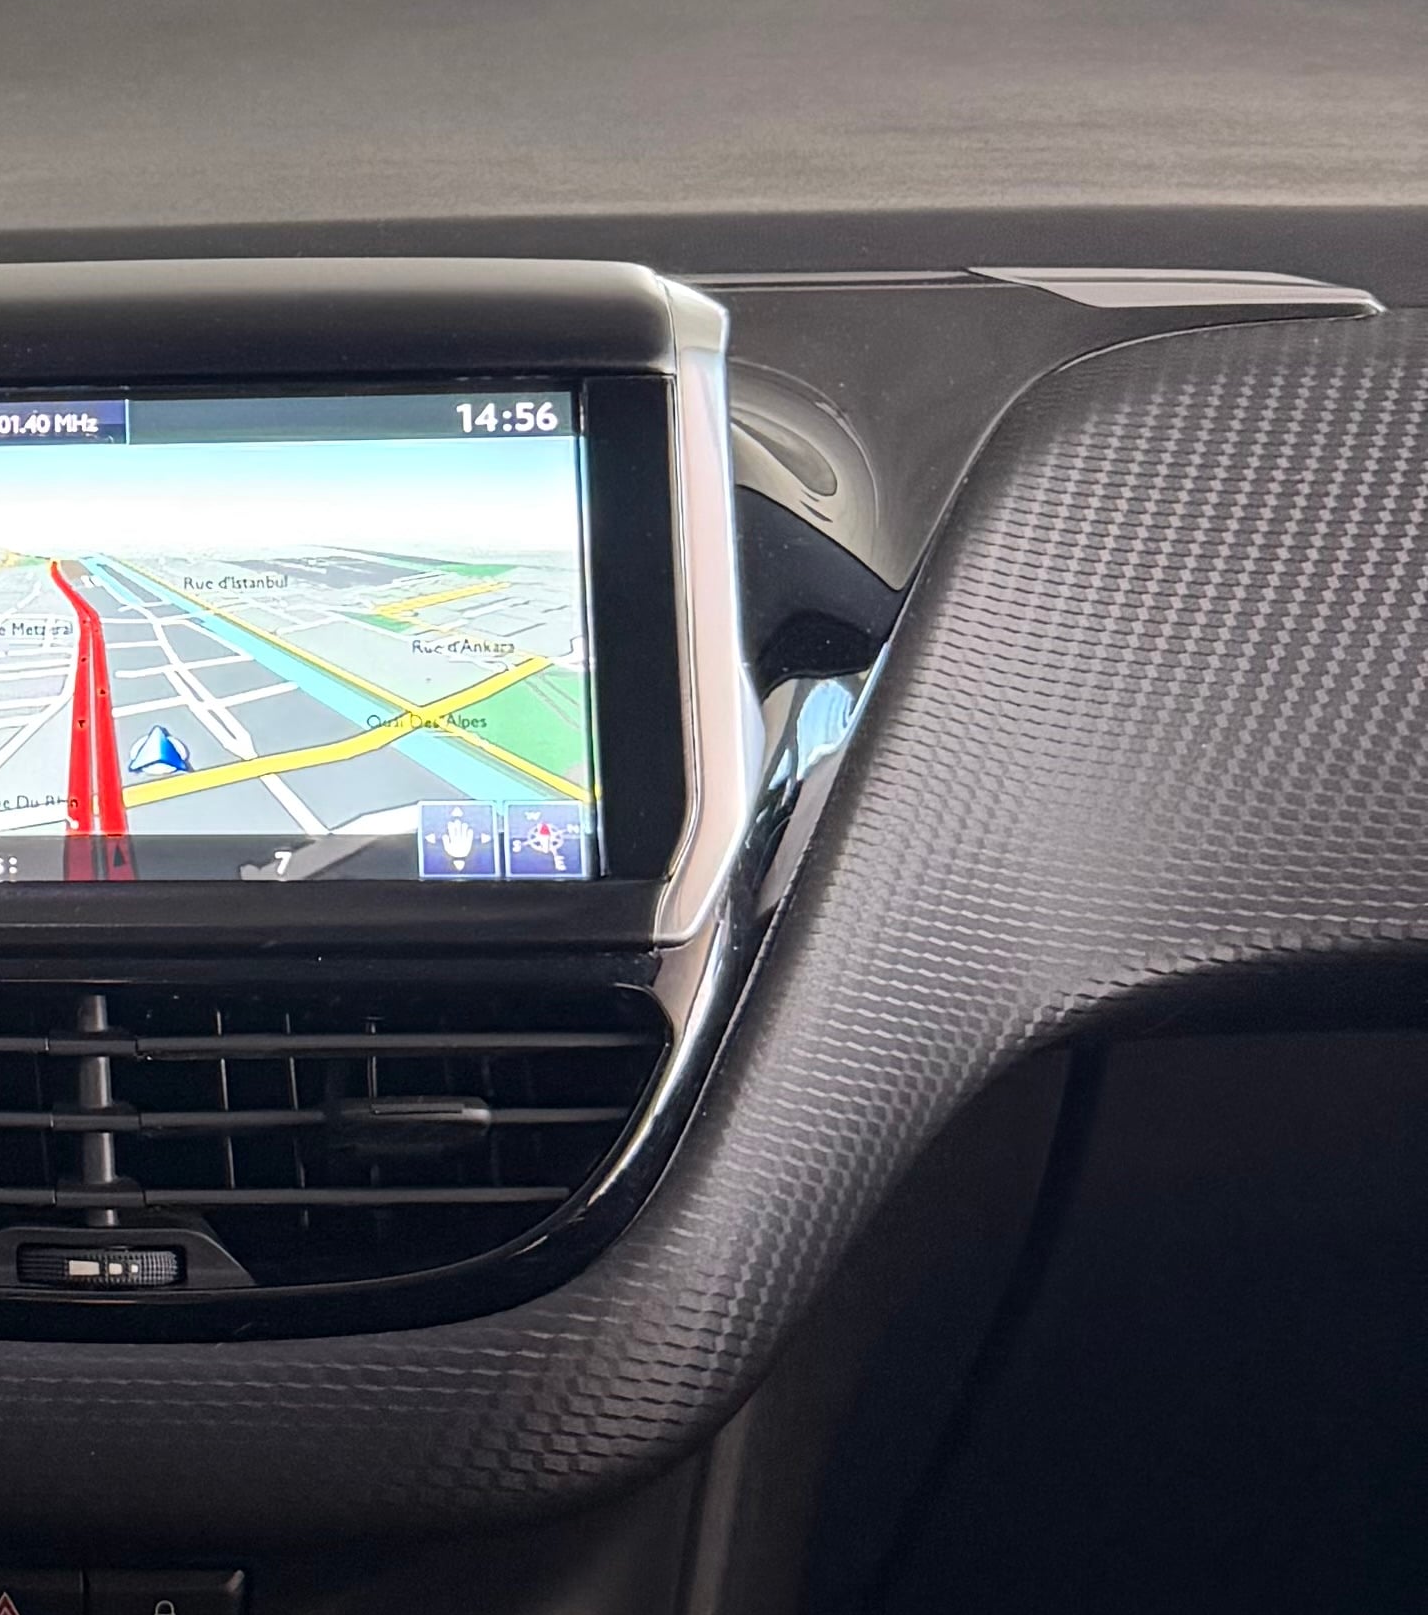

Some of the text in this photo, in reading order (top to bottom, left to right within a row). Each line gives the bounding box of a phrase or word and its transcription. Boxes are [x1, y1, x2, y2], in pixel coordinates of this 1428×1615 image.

[54, 414, 99, 434] MHz
[456, 402, 558, 433] 14:56
[184, 577, 213, 590] Rue
[274, 852, 292, 874] 7
